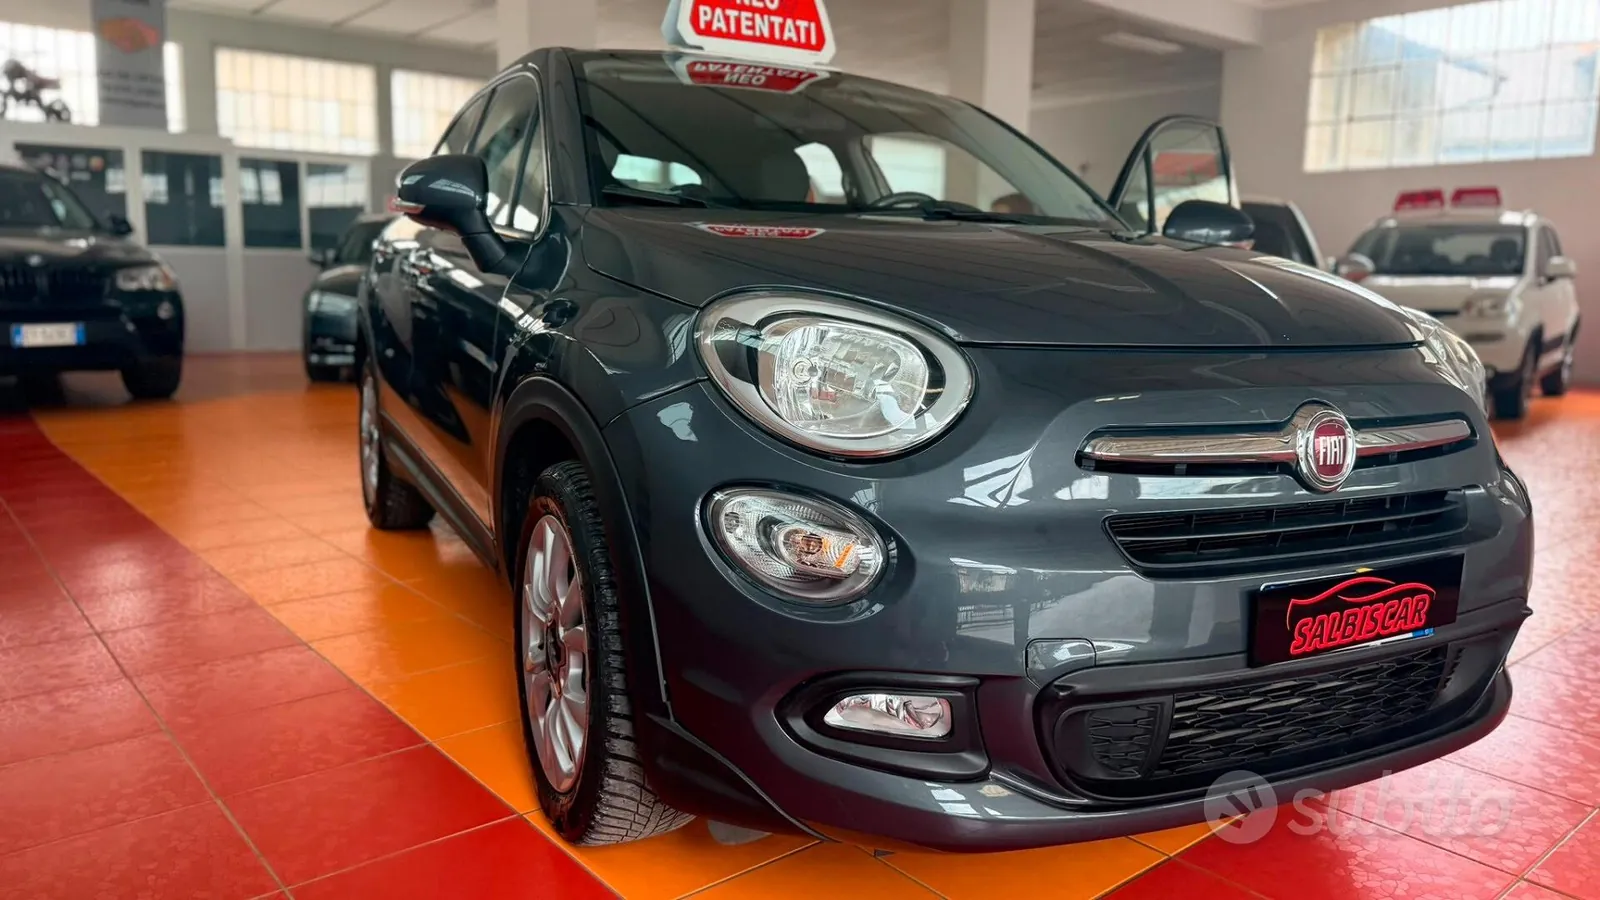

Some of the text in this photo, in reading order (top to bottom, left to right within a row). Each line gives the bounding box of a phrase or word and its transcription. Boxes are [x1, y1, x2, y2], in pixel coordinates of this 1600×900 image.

[698, 5, 817, 45] PATENTATI
[1319, 436, 1345, 465] FIAT
[1290, 594, 1430, 654] SALBISCAR
